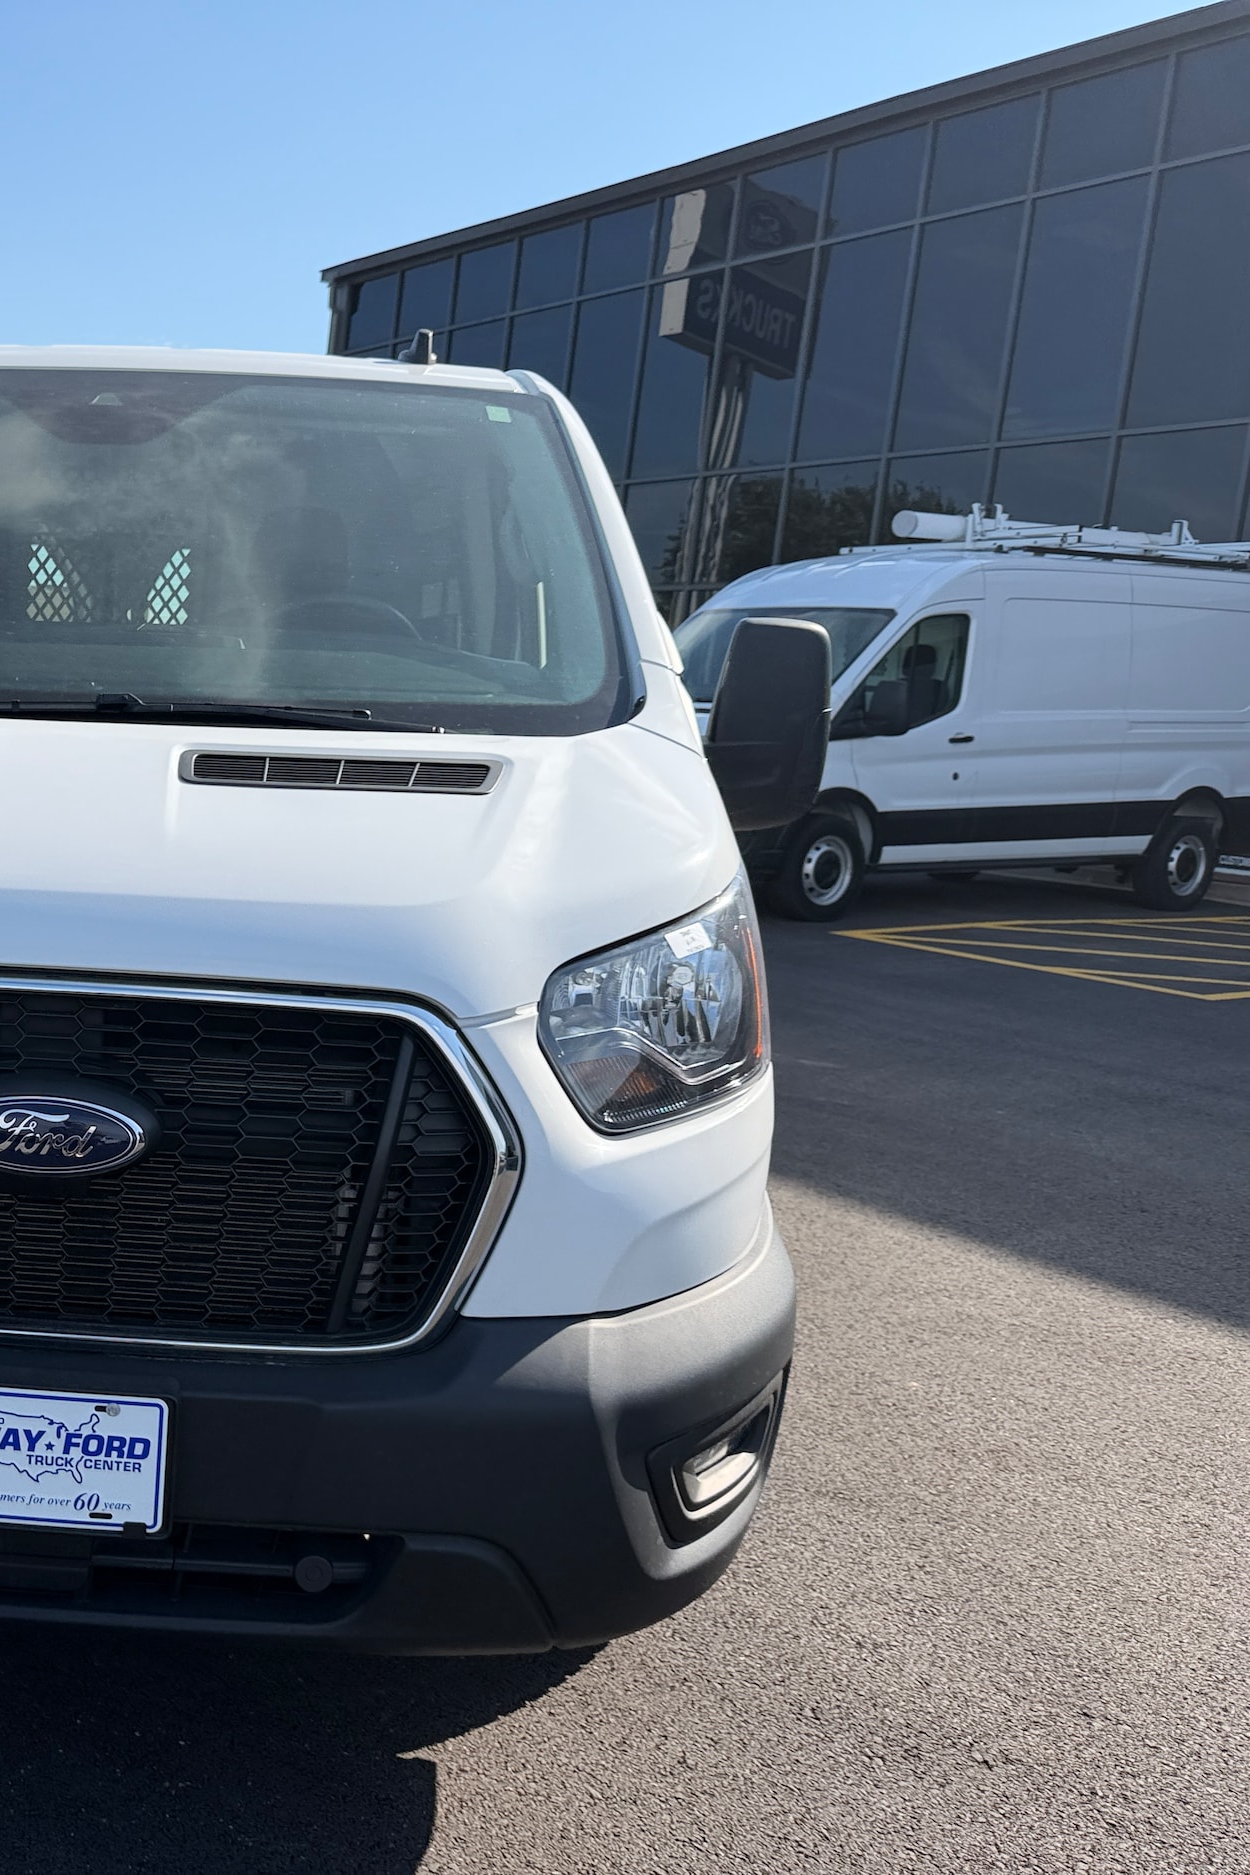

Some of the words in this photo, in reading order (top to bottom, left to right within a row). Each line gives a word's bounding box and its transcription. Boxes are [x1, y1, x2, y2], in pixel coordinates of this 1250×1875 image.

[62, 1432, 152, 1460] FORD
[26, 1454, 74, 1468] TRUCK
[83, 1458, 142, 1473] CENTER
[26, 1494, 46, 1506] for
[47, 1496, 72, 1507] over
[73, 1492, 100, 1512] 60
[101, 1500, 132, 1512] years
